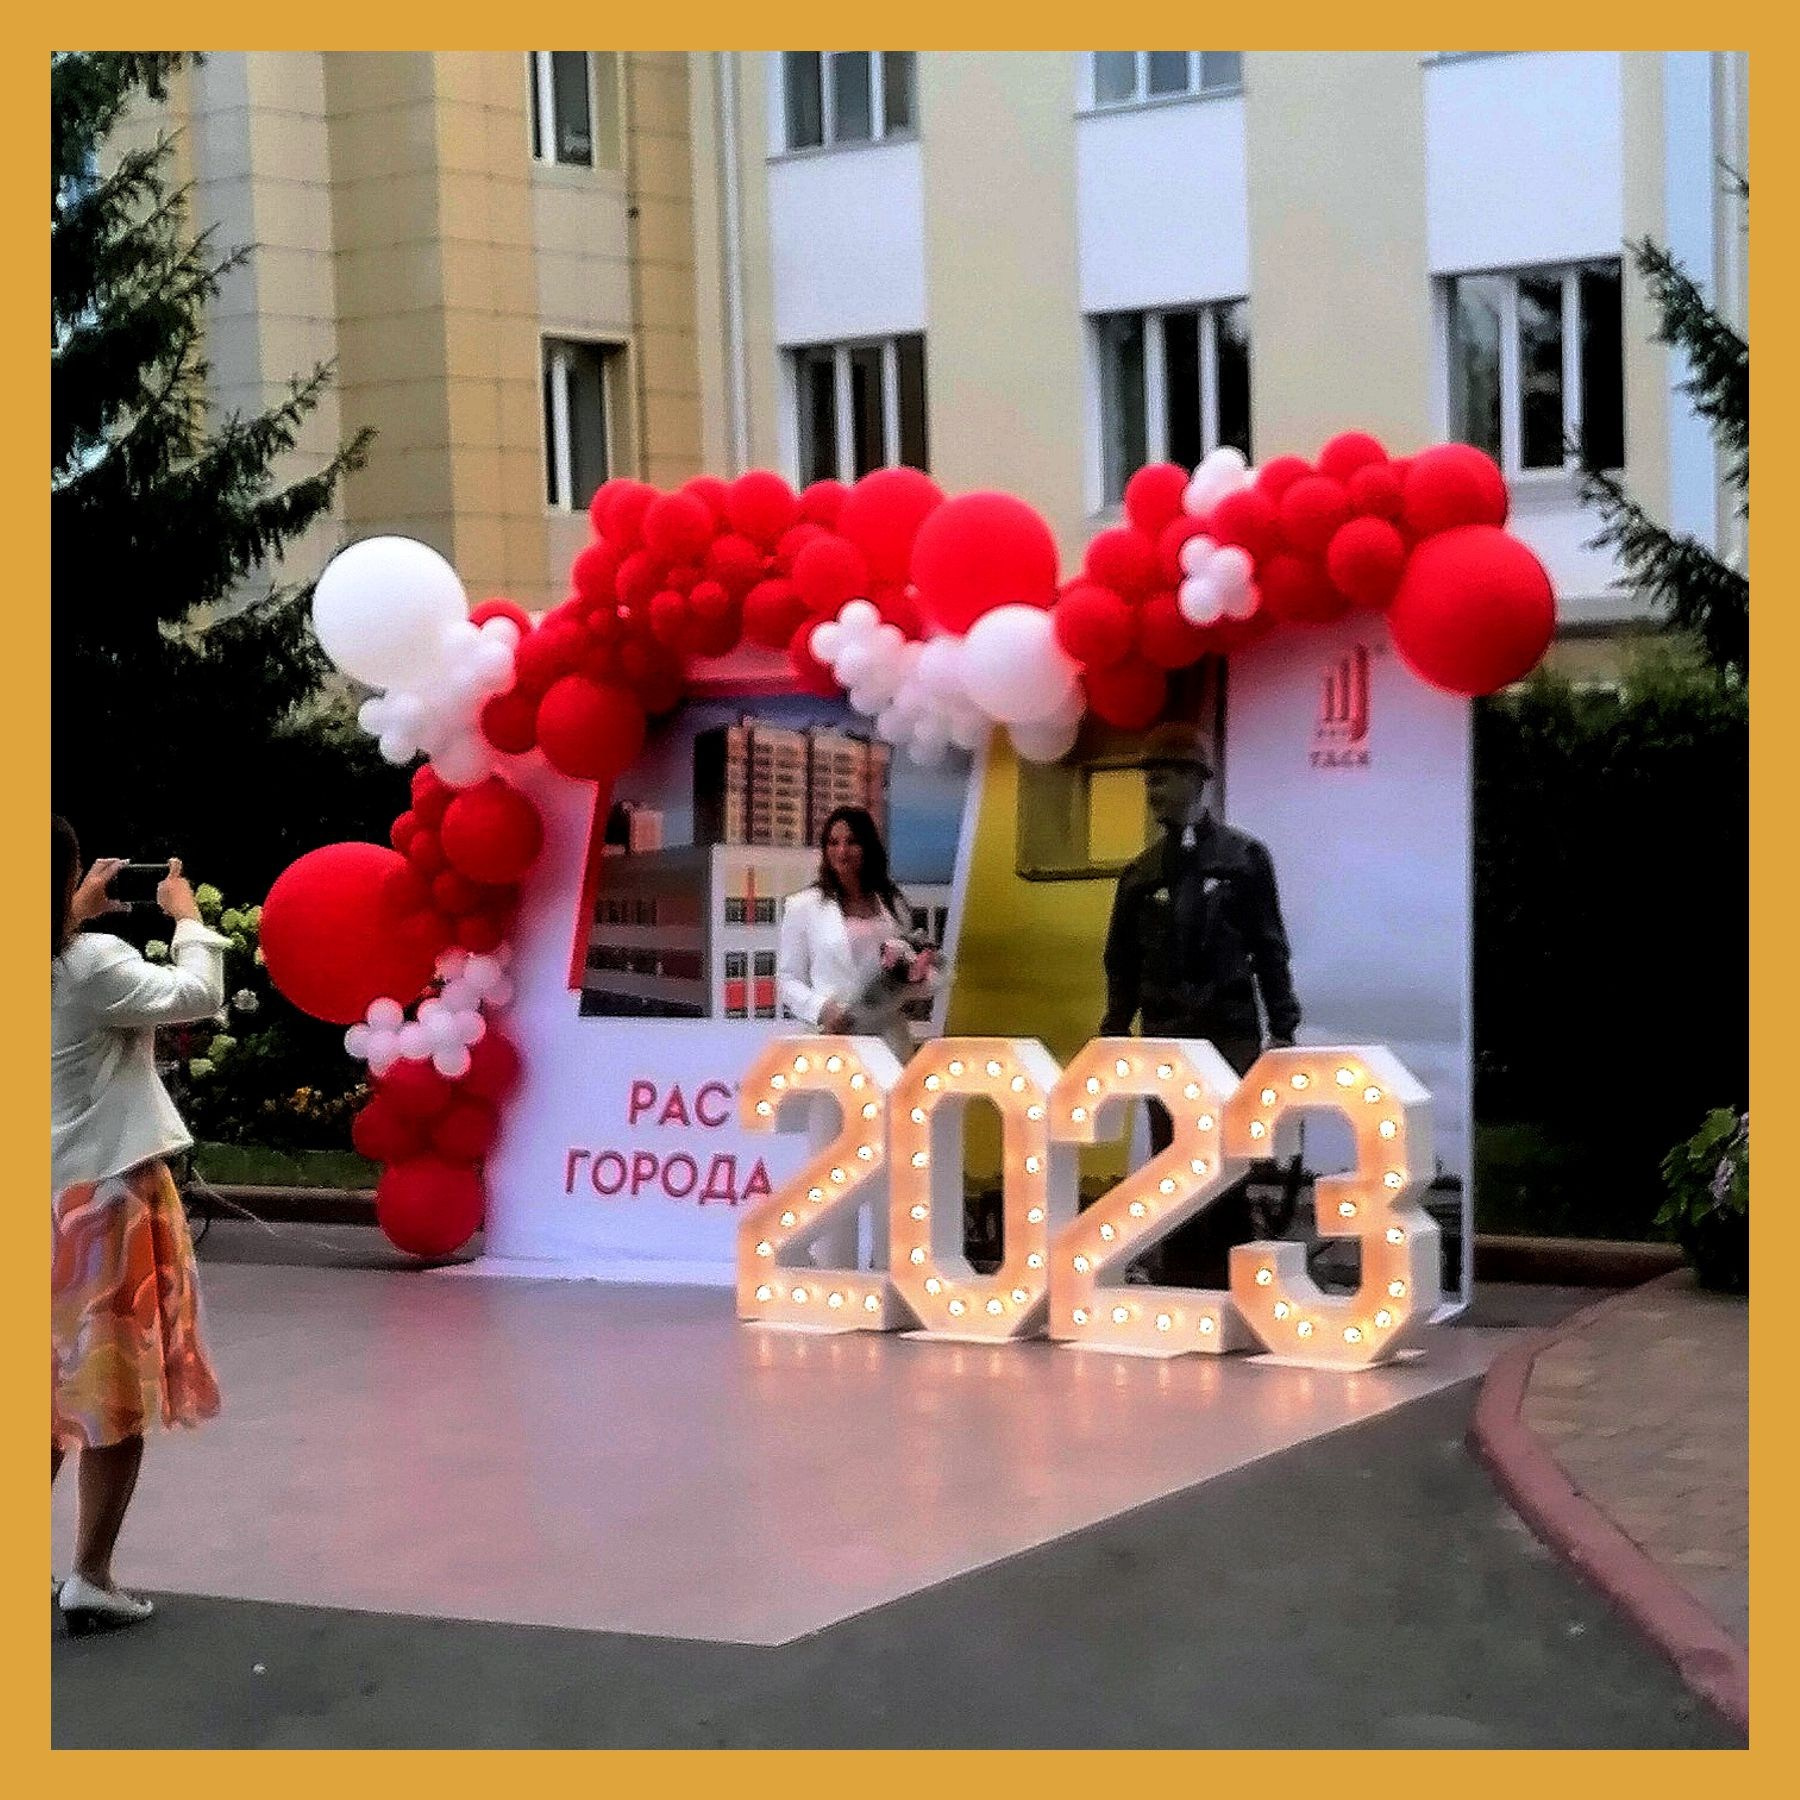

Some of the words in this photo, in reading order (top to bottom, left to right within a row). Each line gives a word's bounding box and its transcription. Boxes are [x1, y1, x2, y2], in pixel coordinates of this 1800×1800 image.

[629, 1079, 741, 1127] РАС
[565, 1149, 773, 1206] ГОРОДА
[737, 1036, 1440, 1368] 2023
